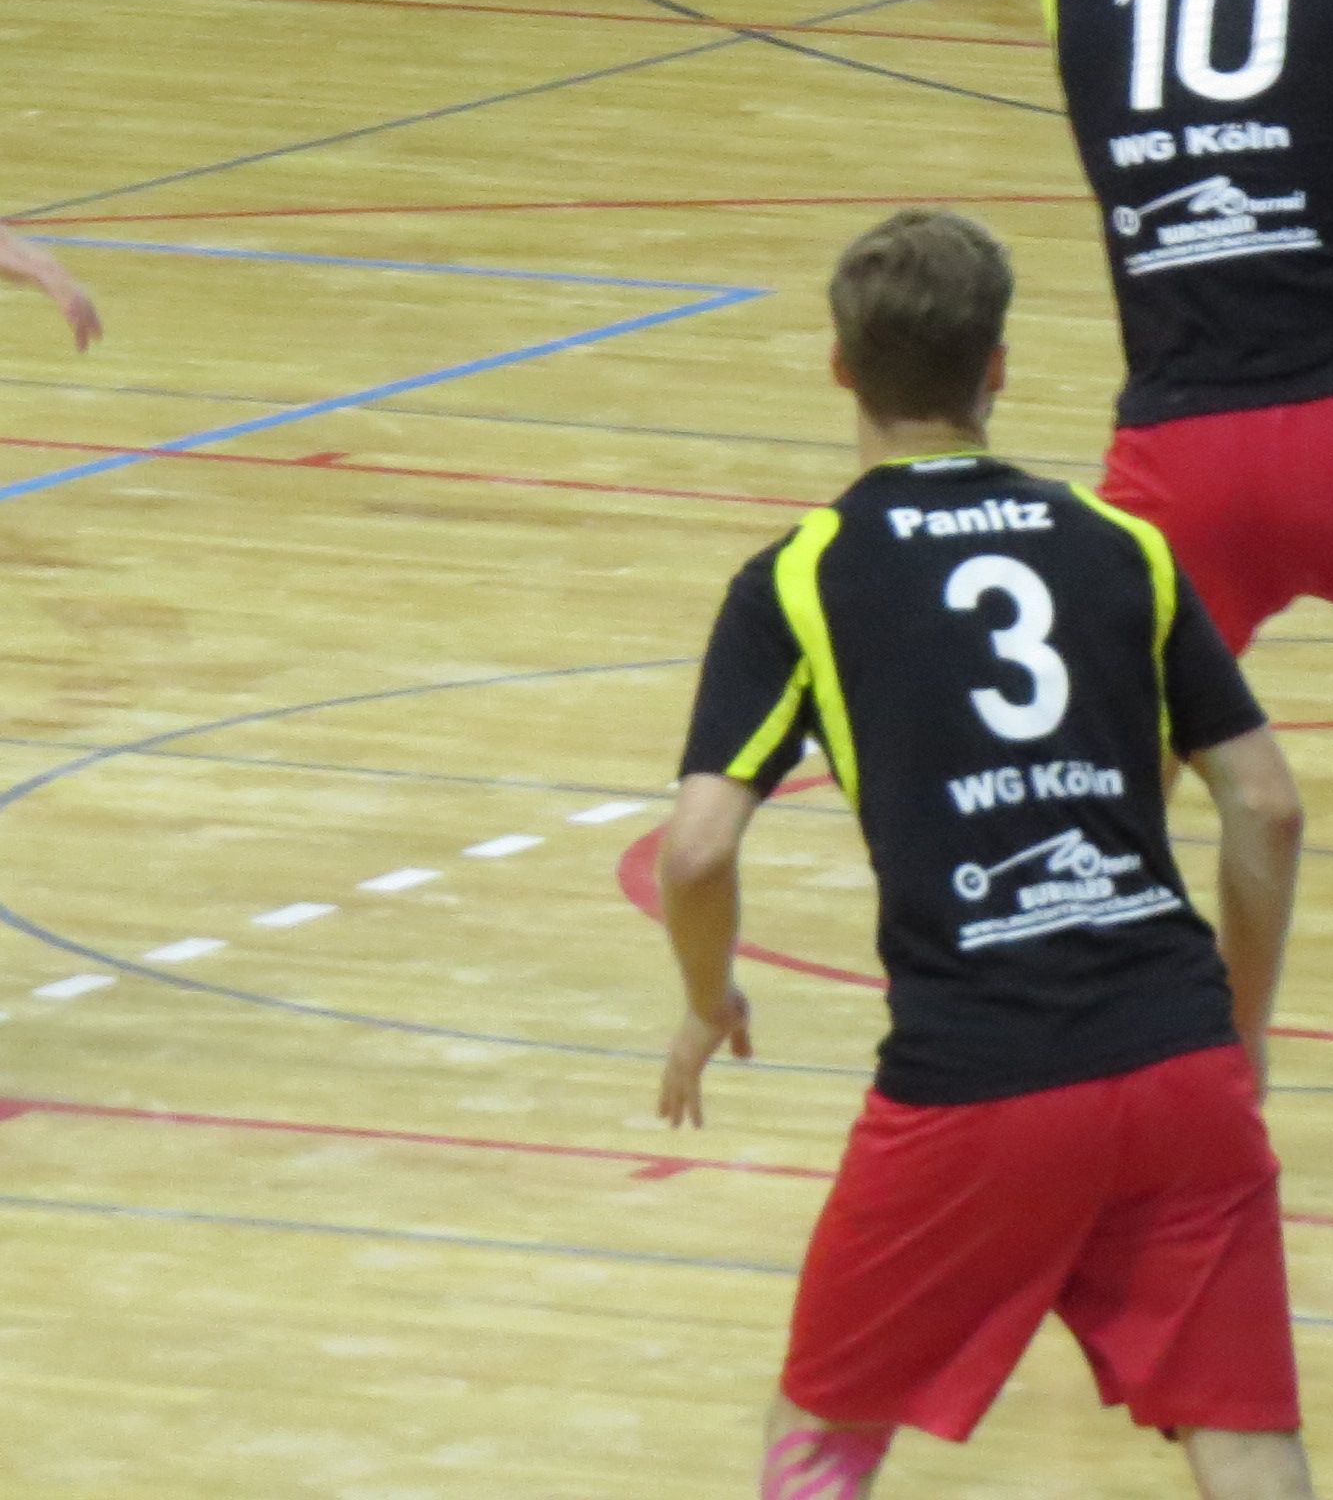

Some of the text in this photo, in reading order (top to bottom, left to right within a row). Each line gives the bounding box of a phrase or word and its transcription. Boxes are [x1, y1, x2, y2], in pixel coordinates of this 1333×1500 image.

[1109, 118, 1292, 168] WG Köln
[887, 499, 1055, 540] Panitz
[943, 553, 1072, 742] 3
[948, 760, 1125, 816] WG Köln
